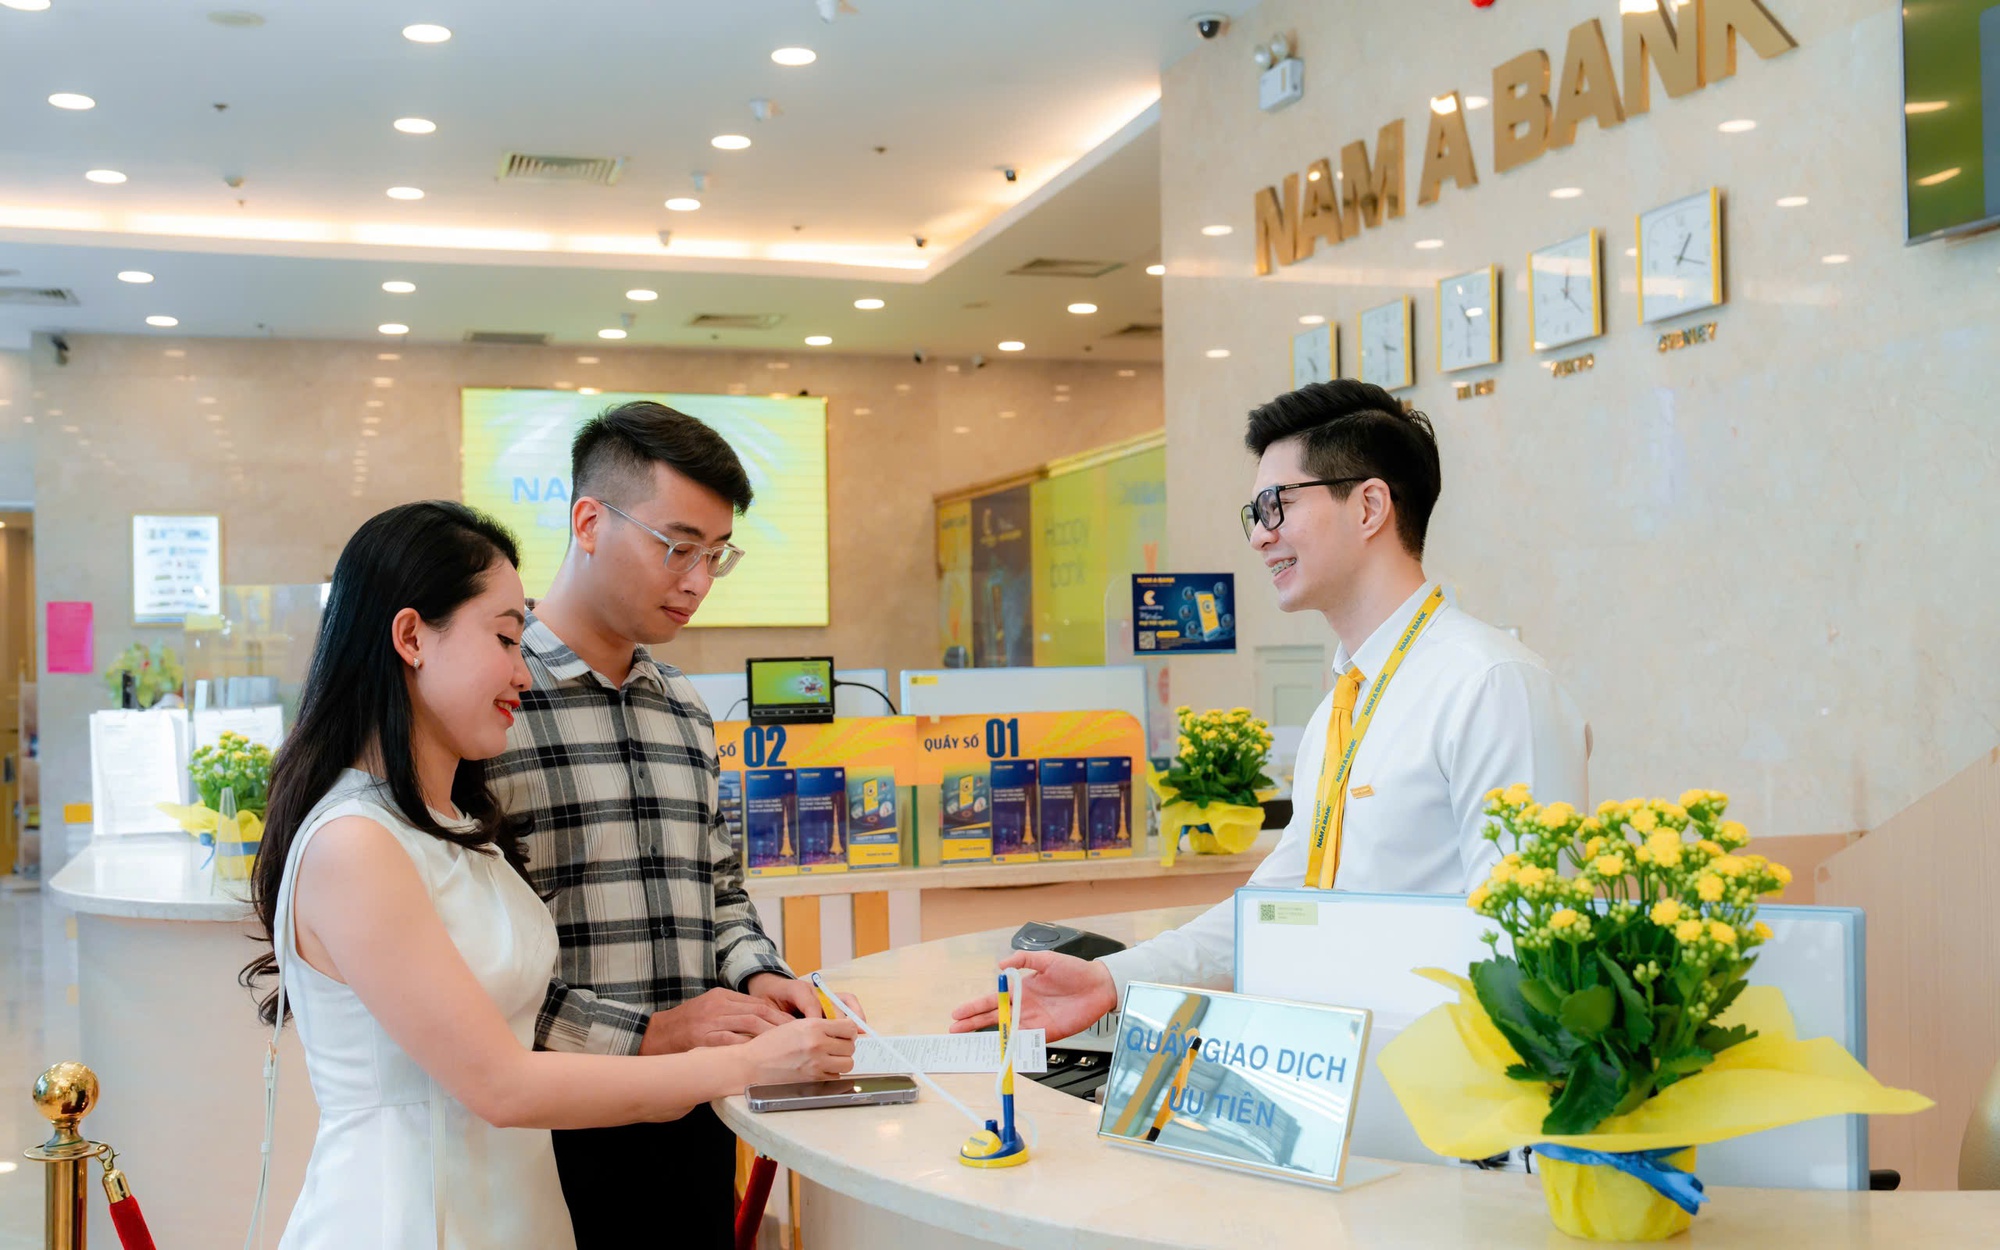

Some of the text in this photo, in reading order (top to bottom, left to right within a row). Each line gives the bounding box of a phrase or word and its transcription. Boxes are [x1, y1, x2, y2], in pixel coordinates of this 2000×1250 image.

[1255, 118, 1405, 276] NAM
[1418, 90, 1479, 206] A
[513, 476, 569, 502] NA
[1398, 634, 1411, 651] NAM
[1412, 611, 1428, 630] BANK
[1364, 698, 1375, 716] NAM
[1375, 672, 1388, 692] BANK
[743, 725, 787, 768] 02
[986, 718, 1019, 758] 01
[1336, 764, 1346, 782] NAM
[1345, 738, 1357, 759] BANK
[1316, 830, 1325, 848] NAM
[1323, 805, 1331, 825] BANK
[1126, 1022, 1347, 1083] QUẦY GIAO DỊCH
[1168, 1086, 1276, 1129] ƯU TIÊN
